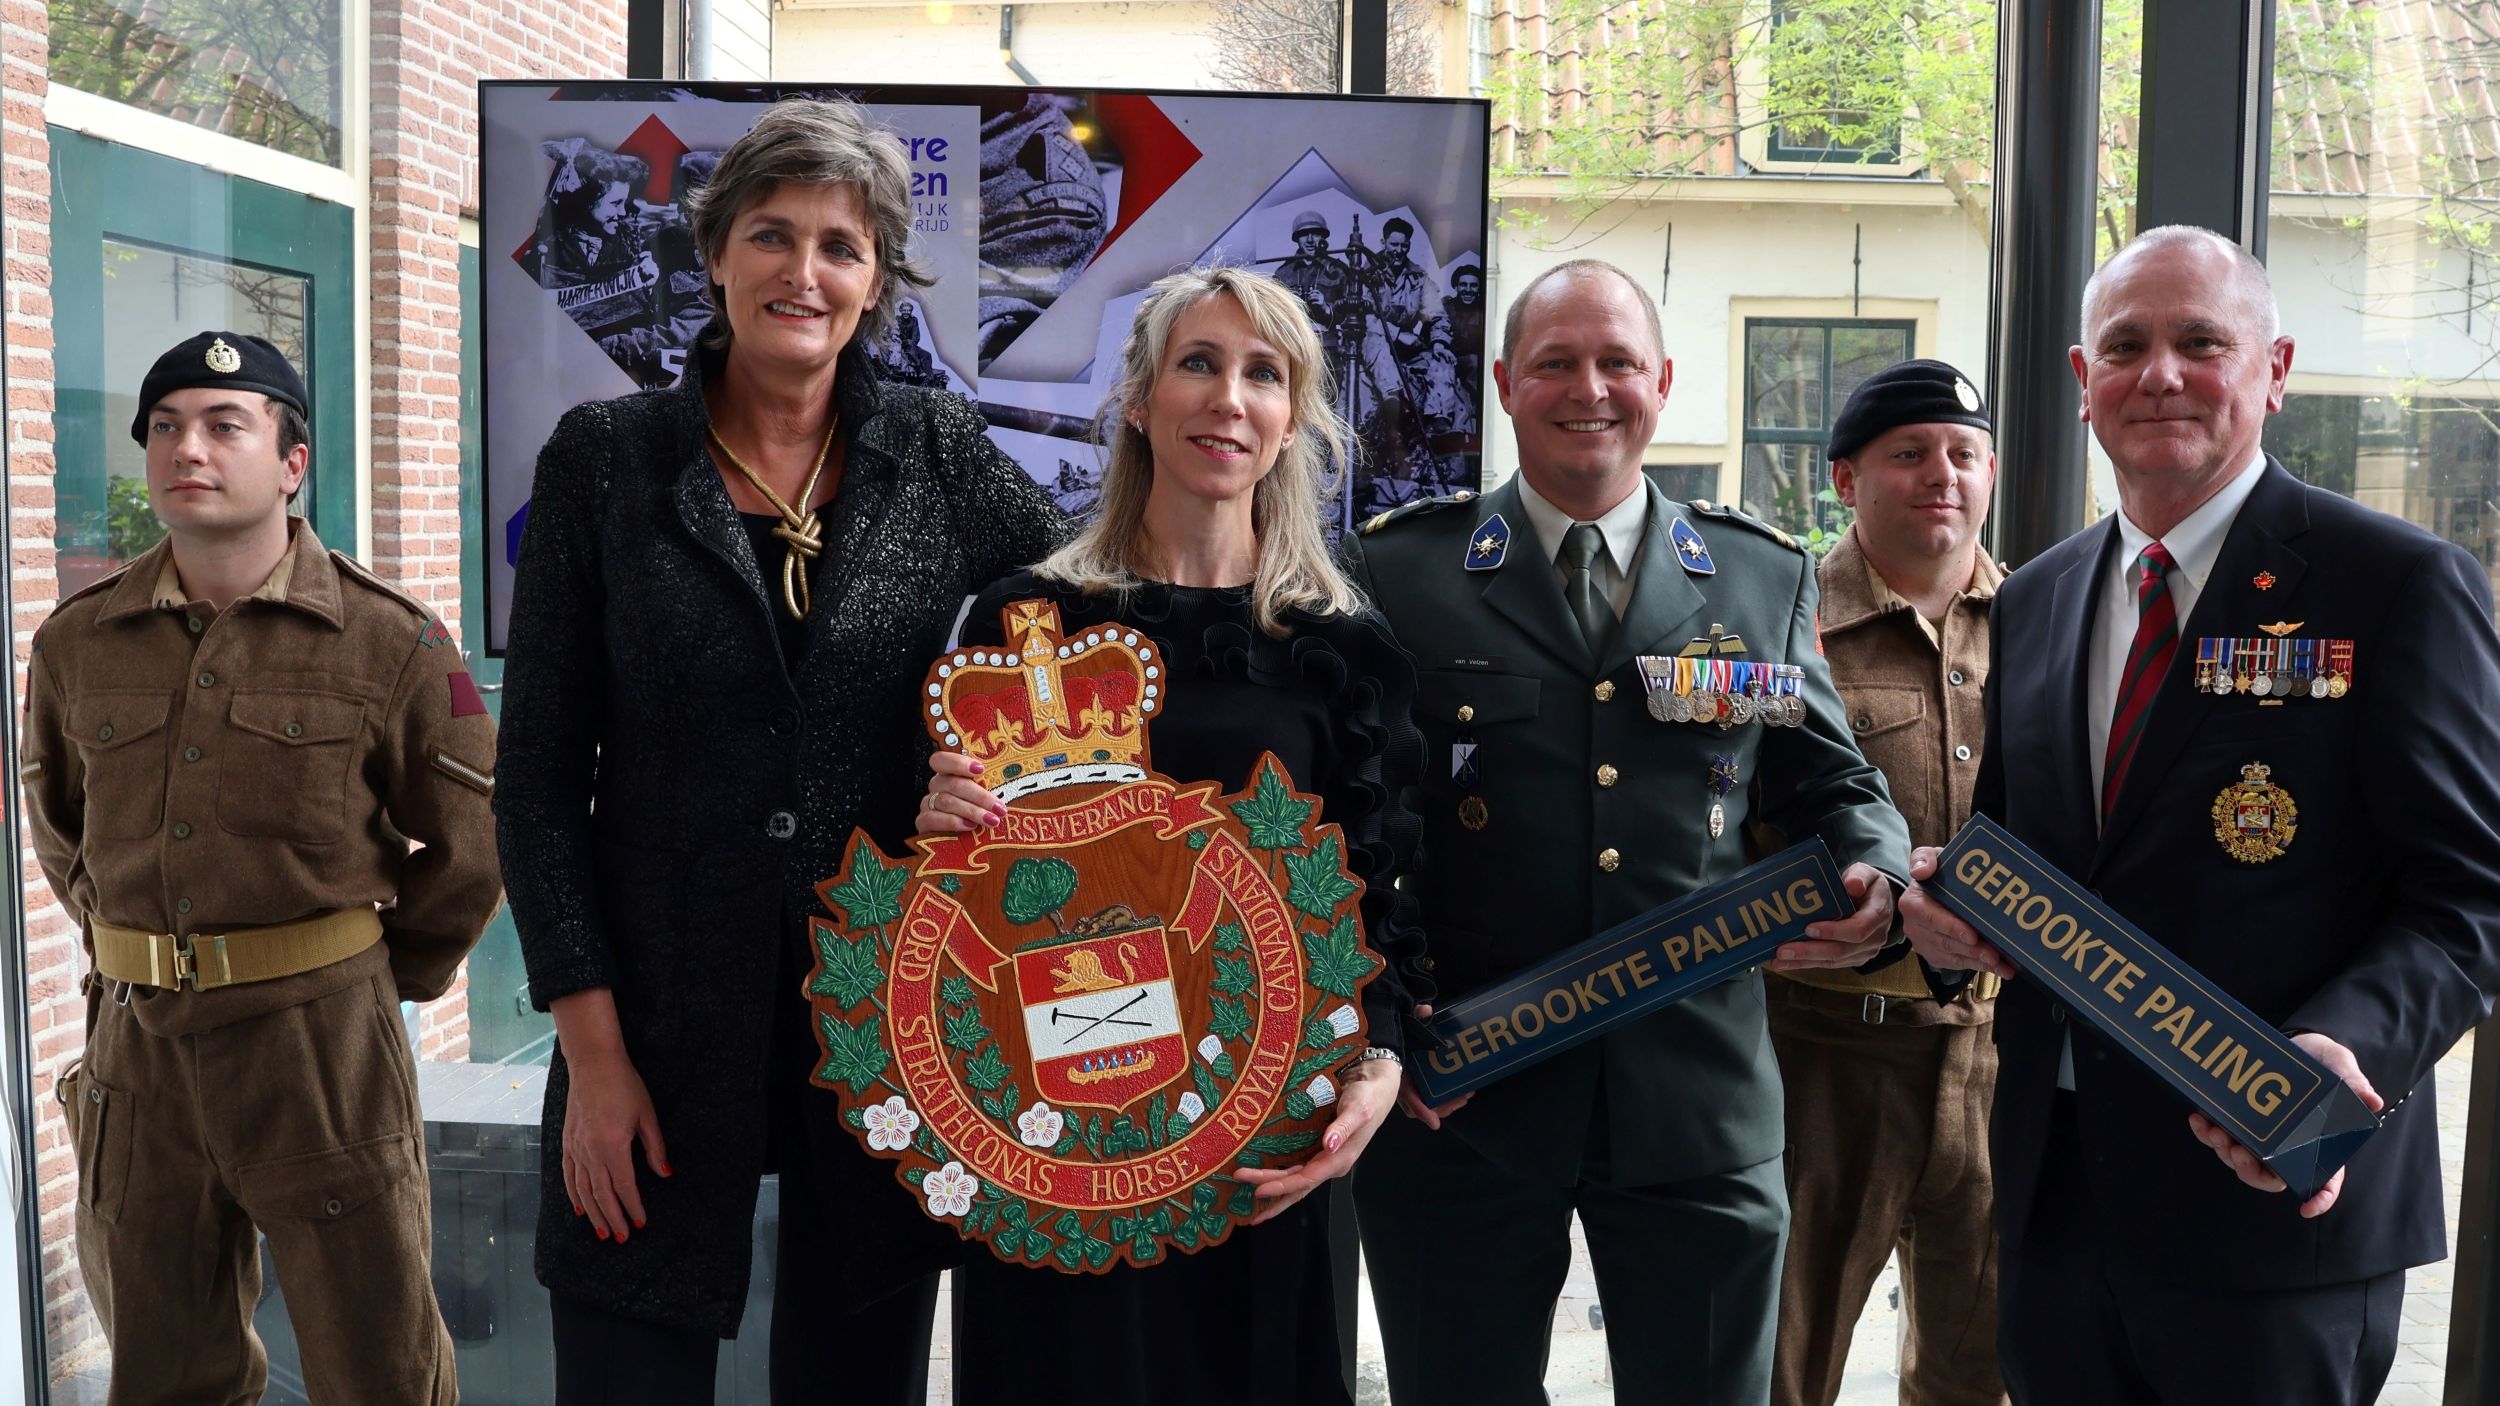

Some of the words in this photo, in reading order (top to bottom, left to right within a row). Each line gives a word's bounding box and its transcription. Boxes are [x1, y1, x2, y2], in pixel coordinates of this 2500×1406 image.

[897, 137, 949, 162] re
[910, 203, 948, 216] IJK
[557, 268, 637, 308] HARDERWIJK
[897, 893, 952, 982] LORD
[1208, 844, 1297, 1013] CANADIANS
[1428, 950, 1660, 1075] GEROOKTE
[1662, 877, 1825, 973] PALING
[1955, 848, 2148, 1003] GEROOKTE
[2134, 985, 2292, 1117] PALING
[897, 1015, 1057, 1196] STRATHCONA'S
[1217, 1041, 1290, 1142] ROYAL
[1091, 1146, 1200, 1202] HORSE
